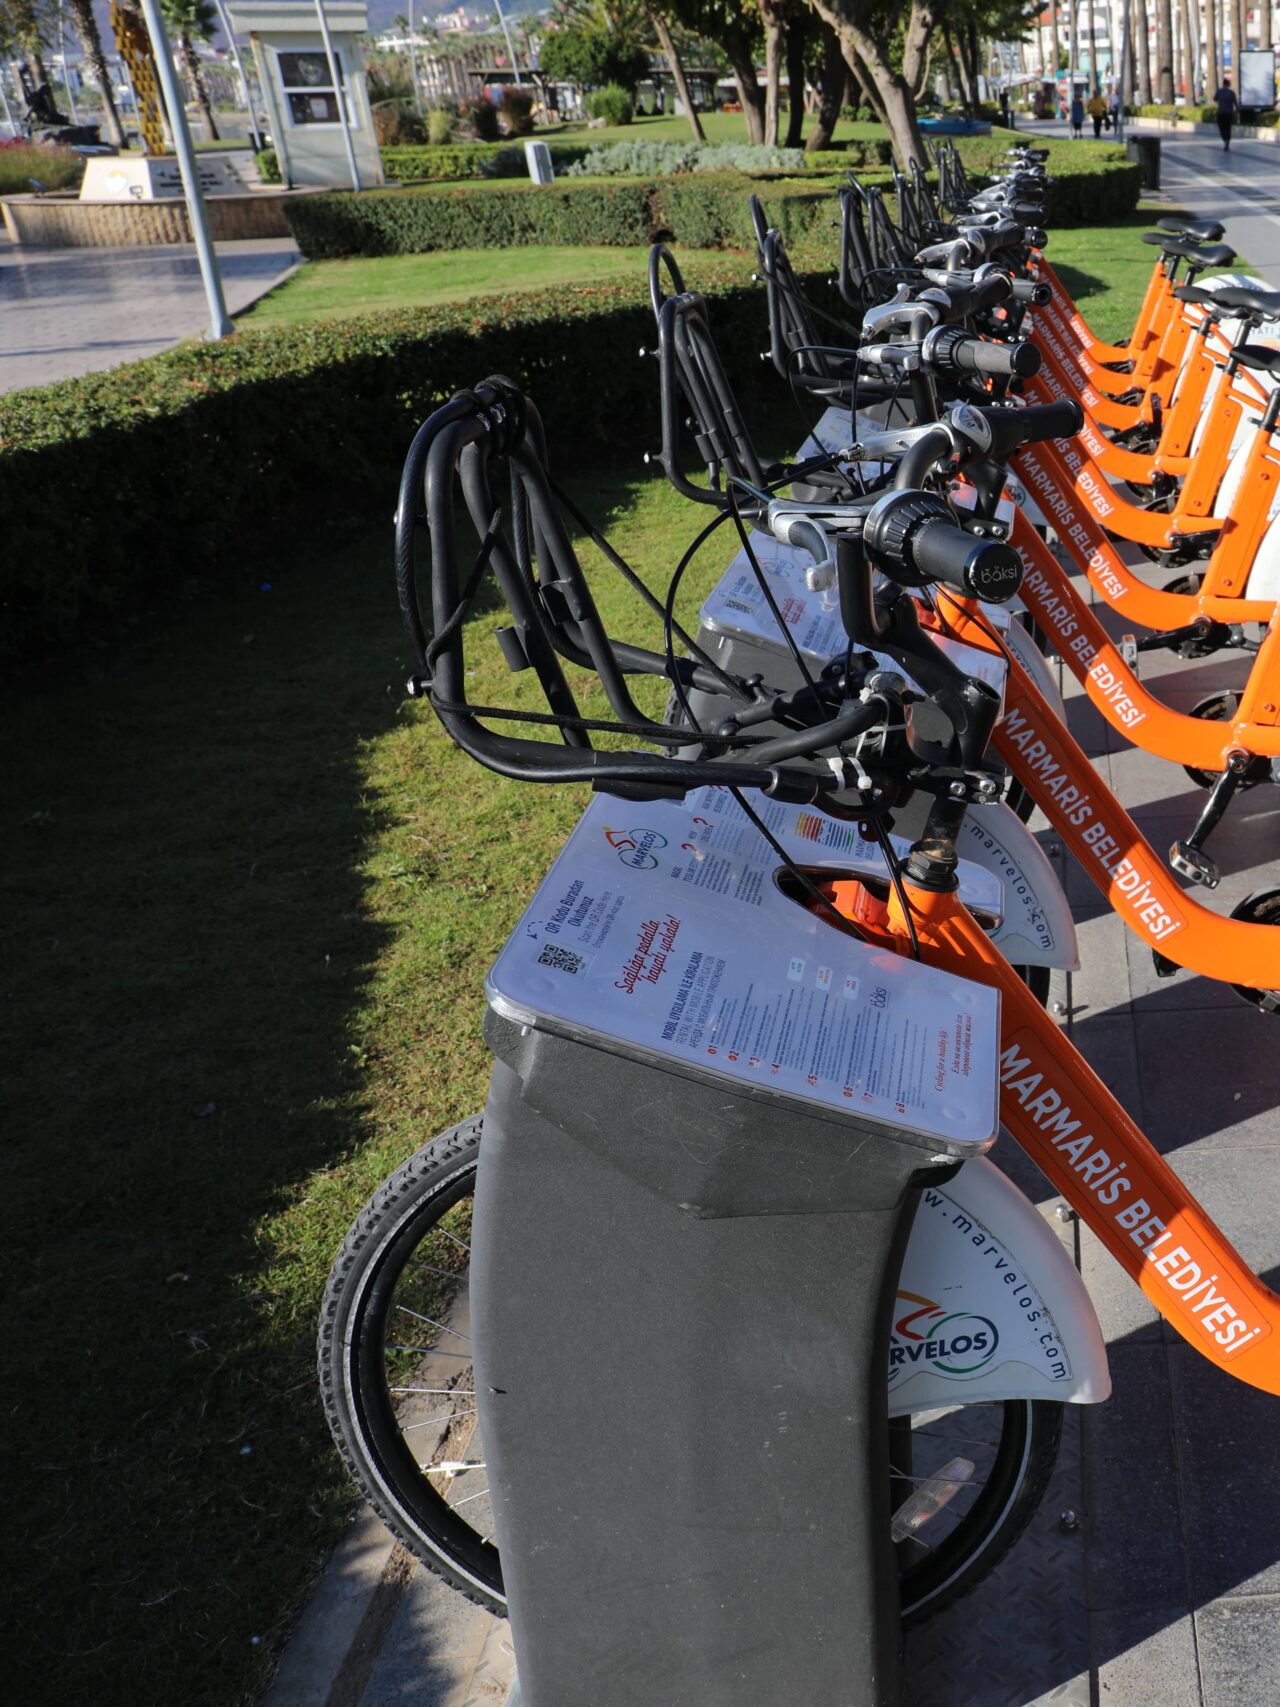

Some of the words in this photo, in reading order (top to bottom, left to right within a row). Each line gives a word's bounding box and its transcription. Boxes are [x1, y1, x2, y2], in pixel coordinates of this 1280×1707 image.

[1063, 451, 1115, 518] BELEDİYESİ
[1018, 451, 1075, 525] MARMARİS
[1068, 523, 1128, 600] BELEDİYESİ
[1069, 634, 1147, 728] BELEDİYESİ
[632, 832, 656, 867] MARVELOS
[1001, 708, 1092, 826] MARMARİS
[1081, 821, 1181, 941] BELEDİYESİ
[555, 903, 570, 924] Kodu
[560, 880, 585, 907] Buradan
[567, 896, 594, 927] Okutunuz
[964, 822, 1052, 949] .marvelos.com
[545, 922, 560, 934] QR
[641, 951, 667, 985] hayatı
[658, 913, 682, 953] yakala!
[614, 953, 647, 994] Sağlığa
[999, 1043, 1132, 1206] MARMARİS
[1114, 1198, 1262, 1354] BELEDİYESİ
[924, 1191, 1067, 1380] w.marvelos.com
[889, 1331, 988, 1366] RVELOS
